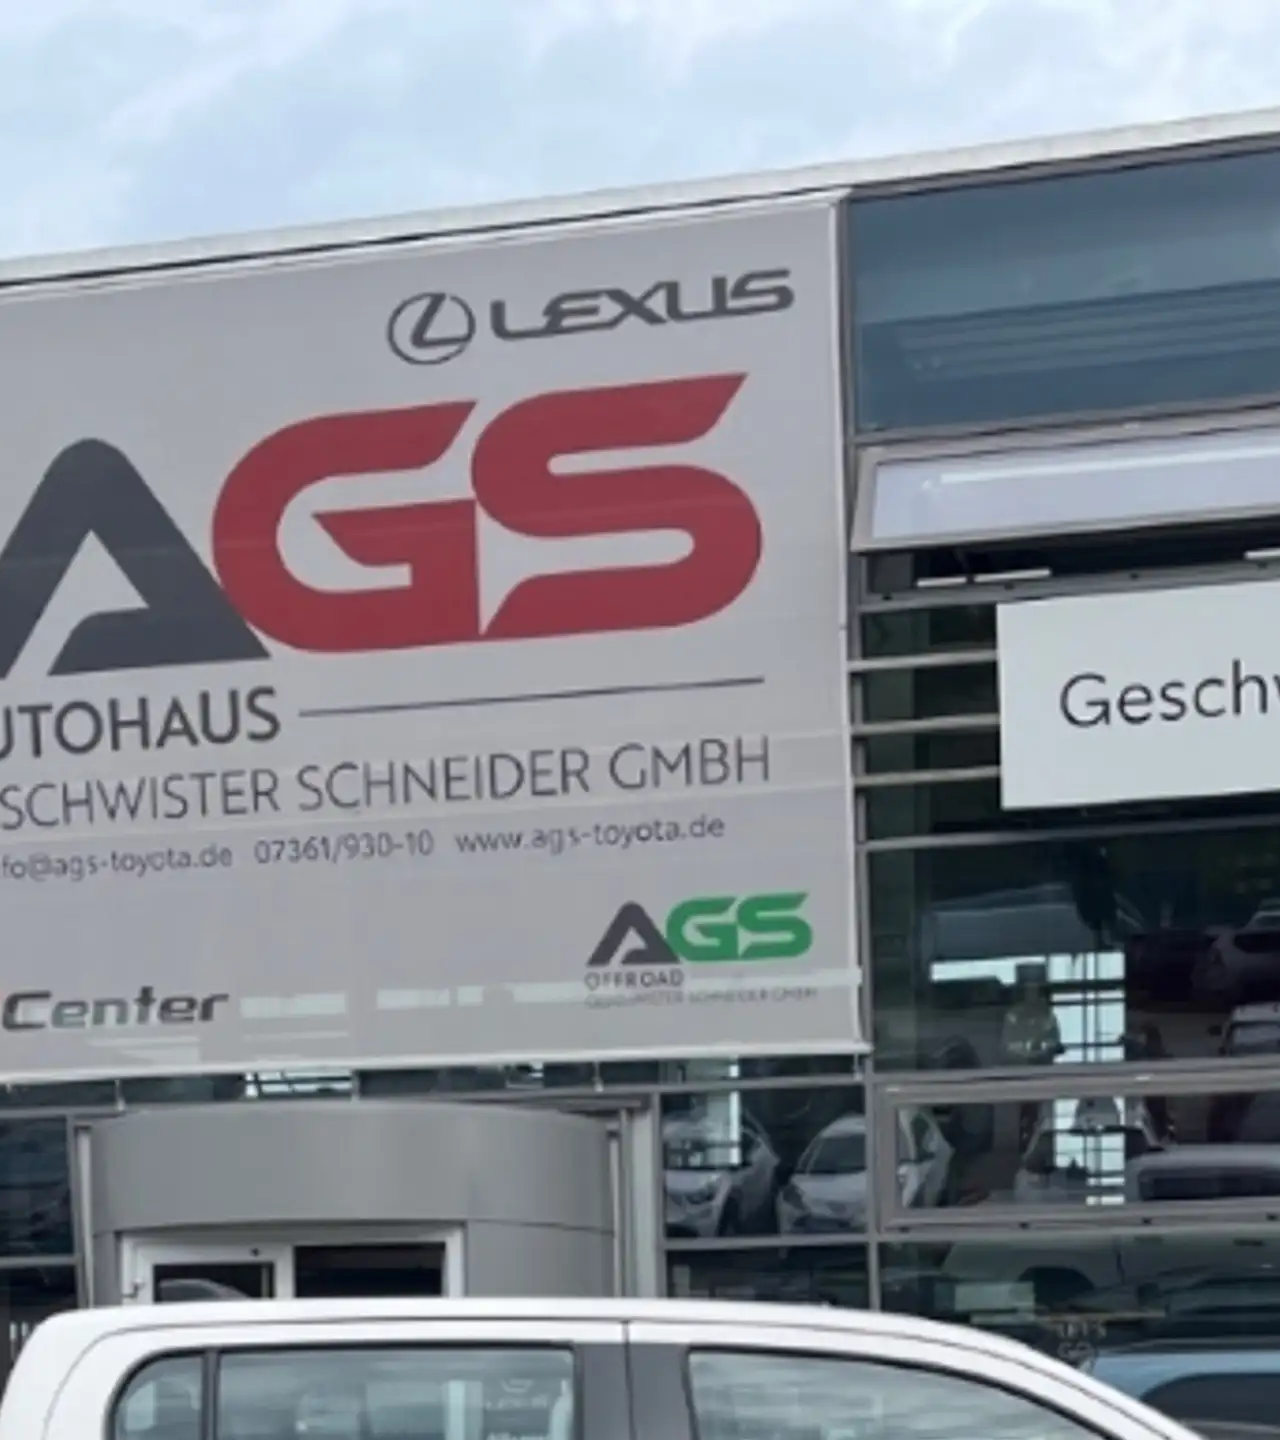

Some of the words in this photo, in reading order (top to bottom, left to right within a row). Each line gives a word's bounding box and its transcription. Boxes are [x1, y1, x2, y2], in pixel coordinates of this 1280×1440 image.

[490, 268, 795, 340] LEXUS
[297, 745, 591, 813] SCHNEIDER
[608, 735, 771, 792] GMBH
[253, 828, 435, 865] 07361/930-10
[455, 813, 726, 856] www.ags-toyota.de
[586, 891, 813, 967] AGS
[2, 986, 230, 1031] Center
[584, 968, 685, 991] OFFROAD
